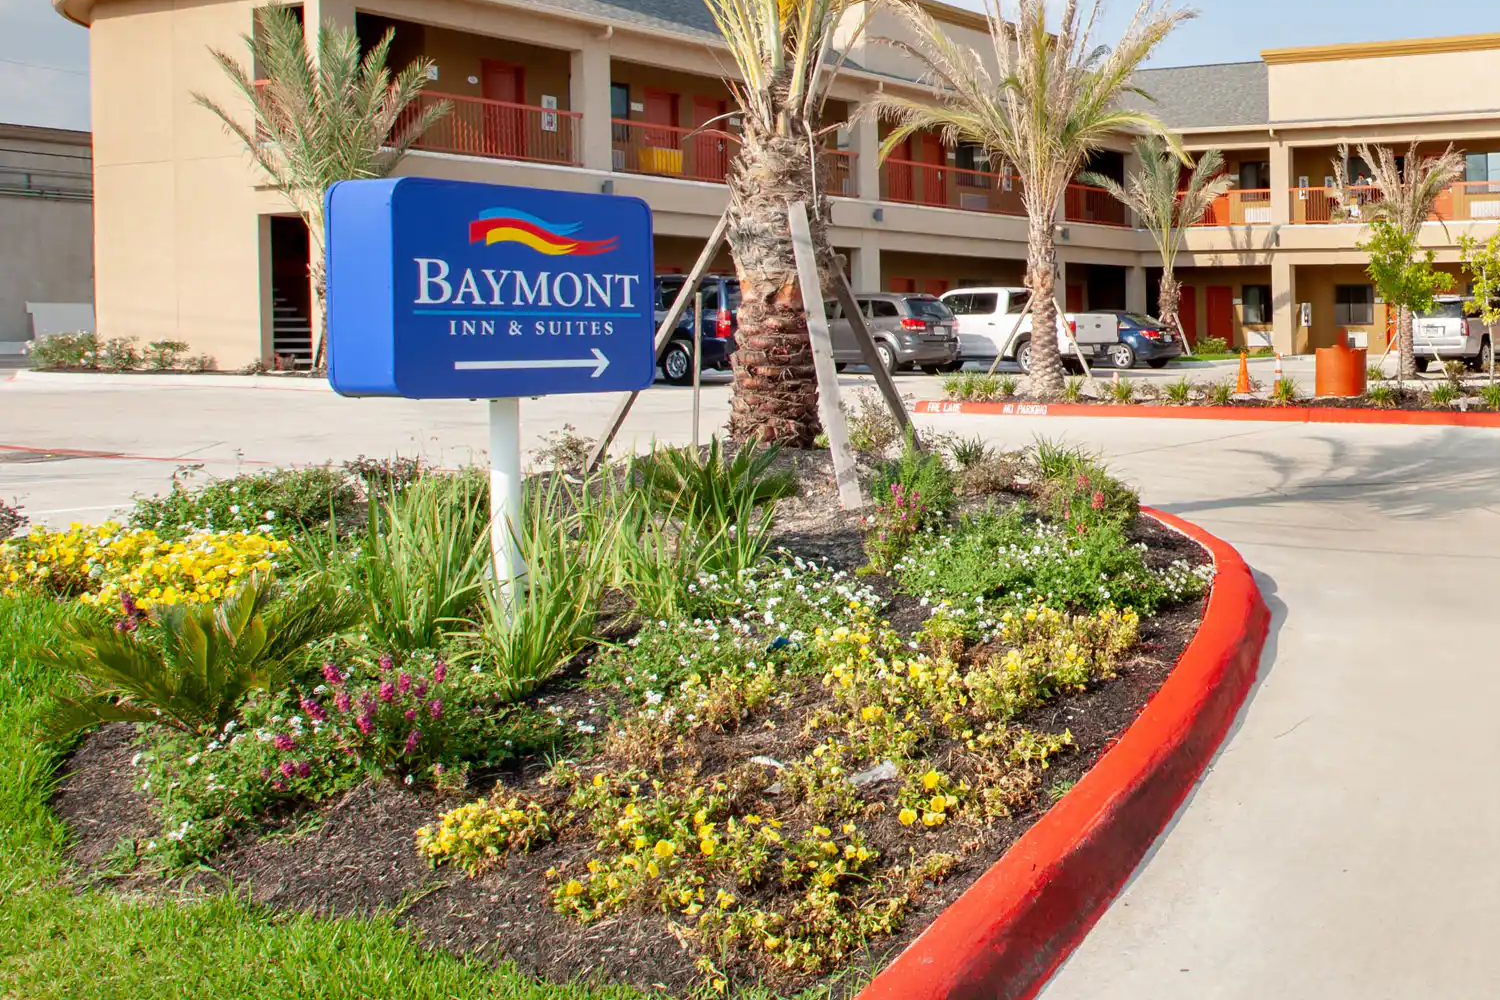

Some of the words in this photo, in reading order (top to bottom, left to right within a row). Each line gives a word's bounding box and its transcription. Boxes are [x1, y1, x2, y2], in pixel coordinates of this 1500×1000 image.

[412, 257, 640, 308] BAYMONT
[448, 320, 495, 336] INN
[508, 320, 523, 336] &
[535, 320, 614, 336] SUITES
[1002, 403, 1014, 414] NO
